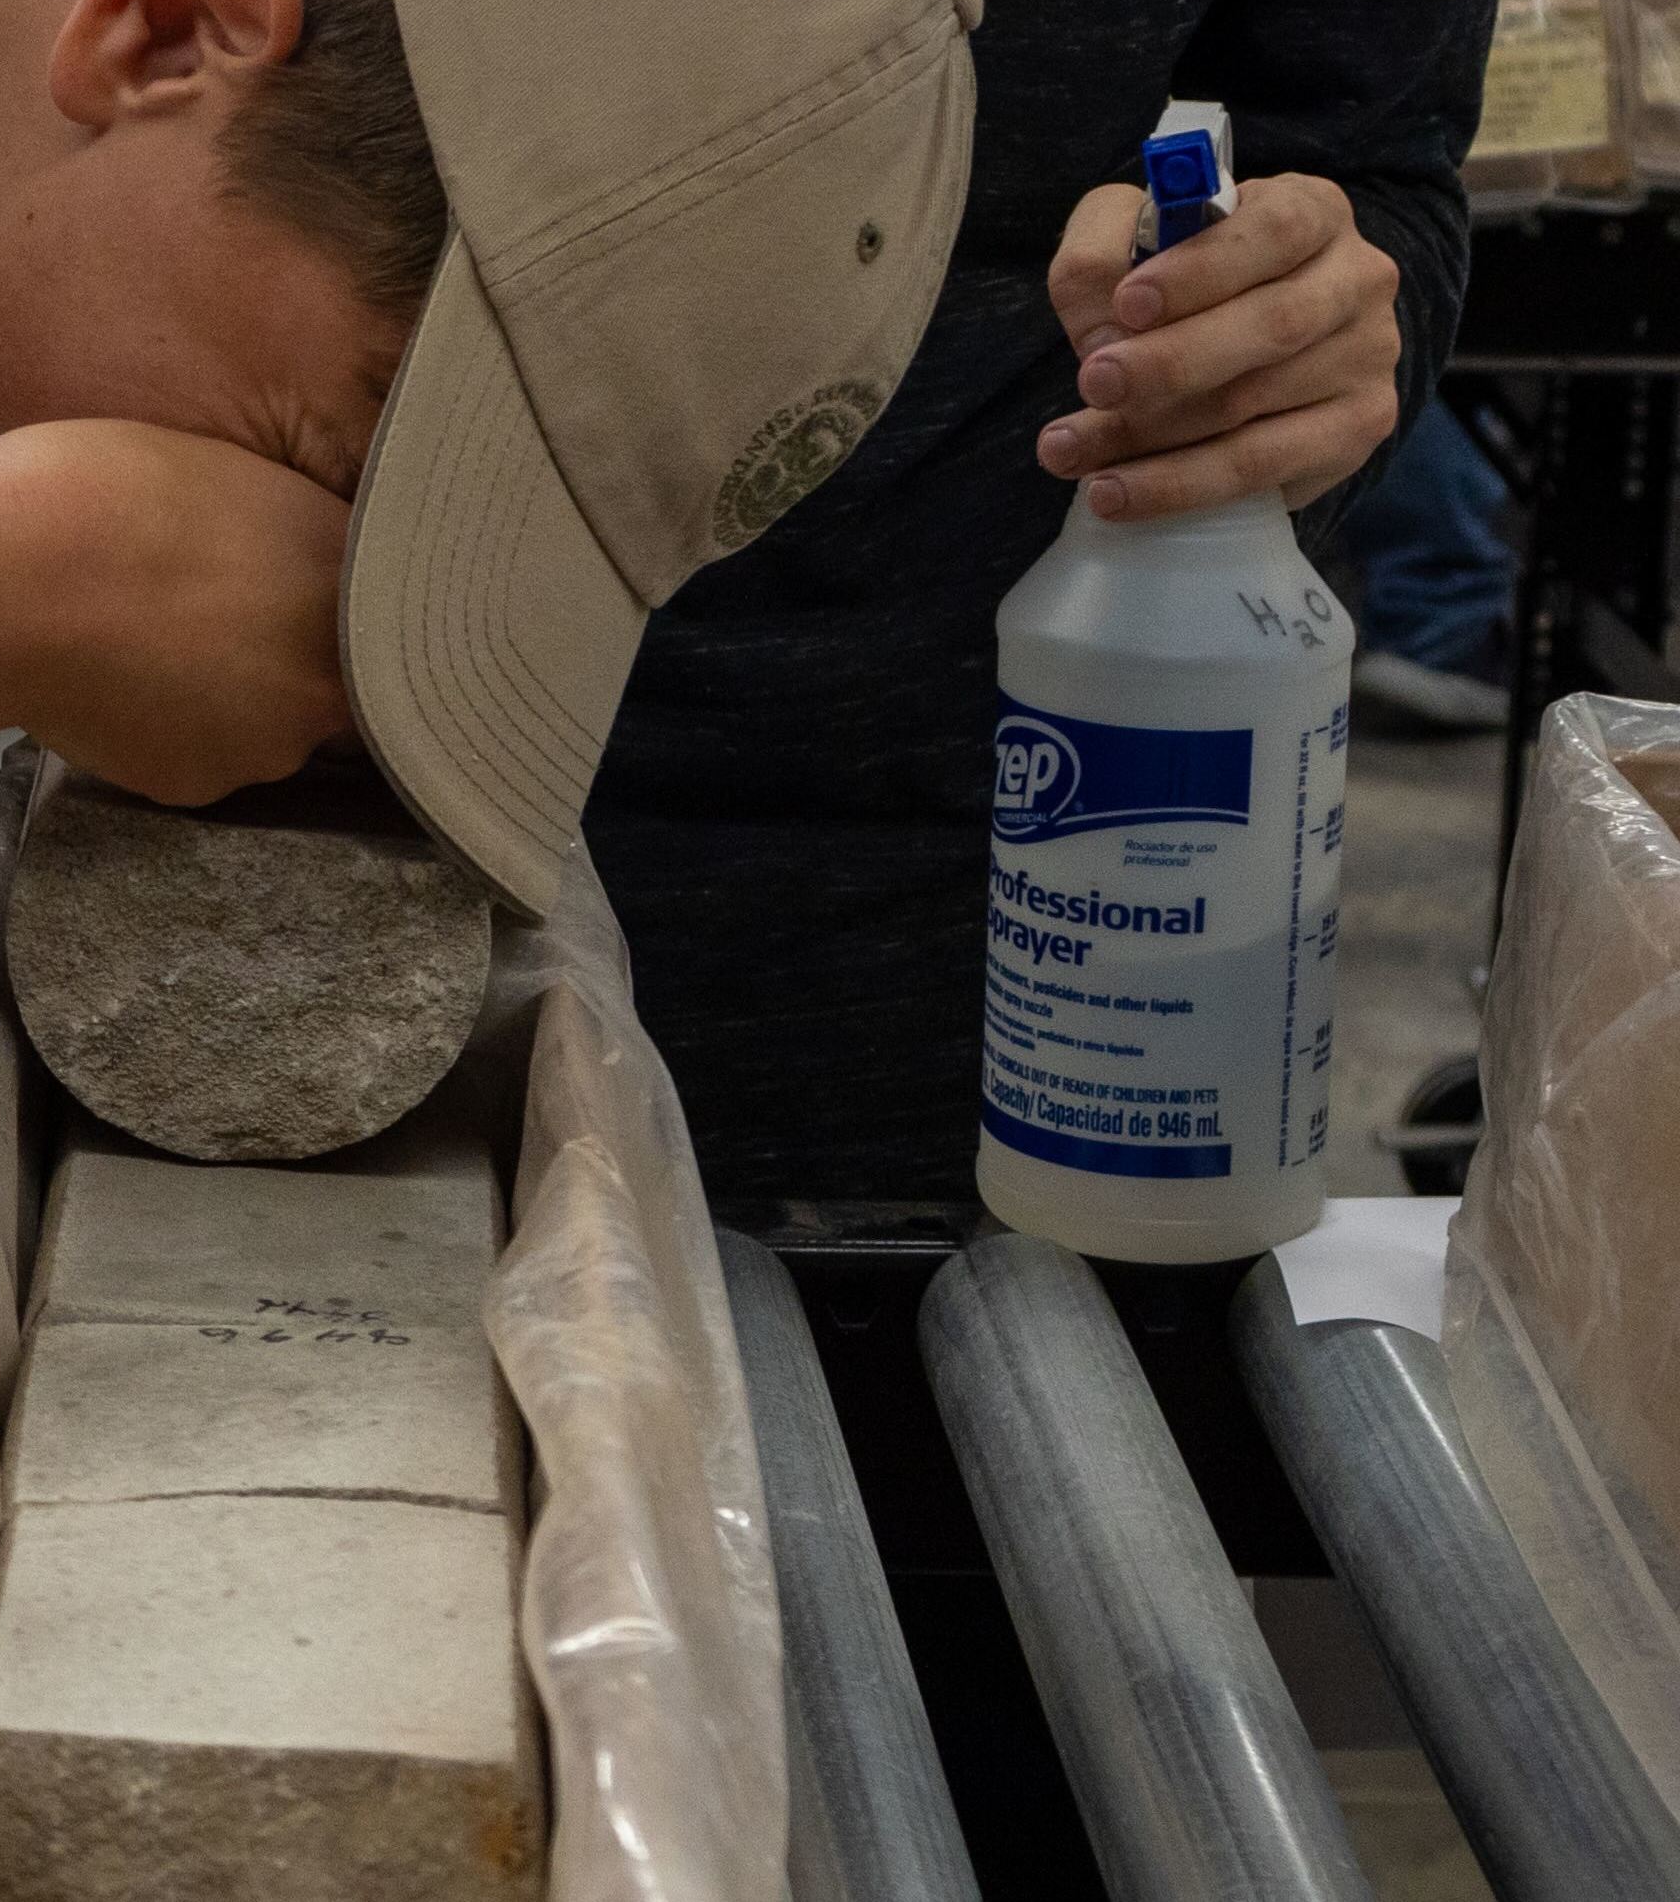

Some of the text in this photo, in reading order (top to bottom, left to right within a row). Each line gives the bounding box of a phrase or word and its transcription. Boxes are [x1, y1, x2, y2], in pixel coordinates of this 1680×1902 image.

[1179, 841, 1194, 852] de
[1088, 994, 1110, 1008] and
[1114, 996, 1147, 1012] other
[1150, 997, 1194, 1016] liquids
[1031, 1067, 1047, 1086] OUT
[1049, 1072, 1061, 1089] OF
[1063, 1076, 1095, 1097] REACH
[1096, 1083, 1111, 1099] OF
[1112, 1086, 1166, 1104] CHILDREN
[1168, 1089, 1191, 1104] AND
[1193, 1088, 1218, 1104] PETS
[1038, 1093, 1124, 1135] Capacidad
[1128, 1110, 1152, 1137] de
[1157, 1111, 1191, 1139] 946
